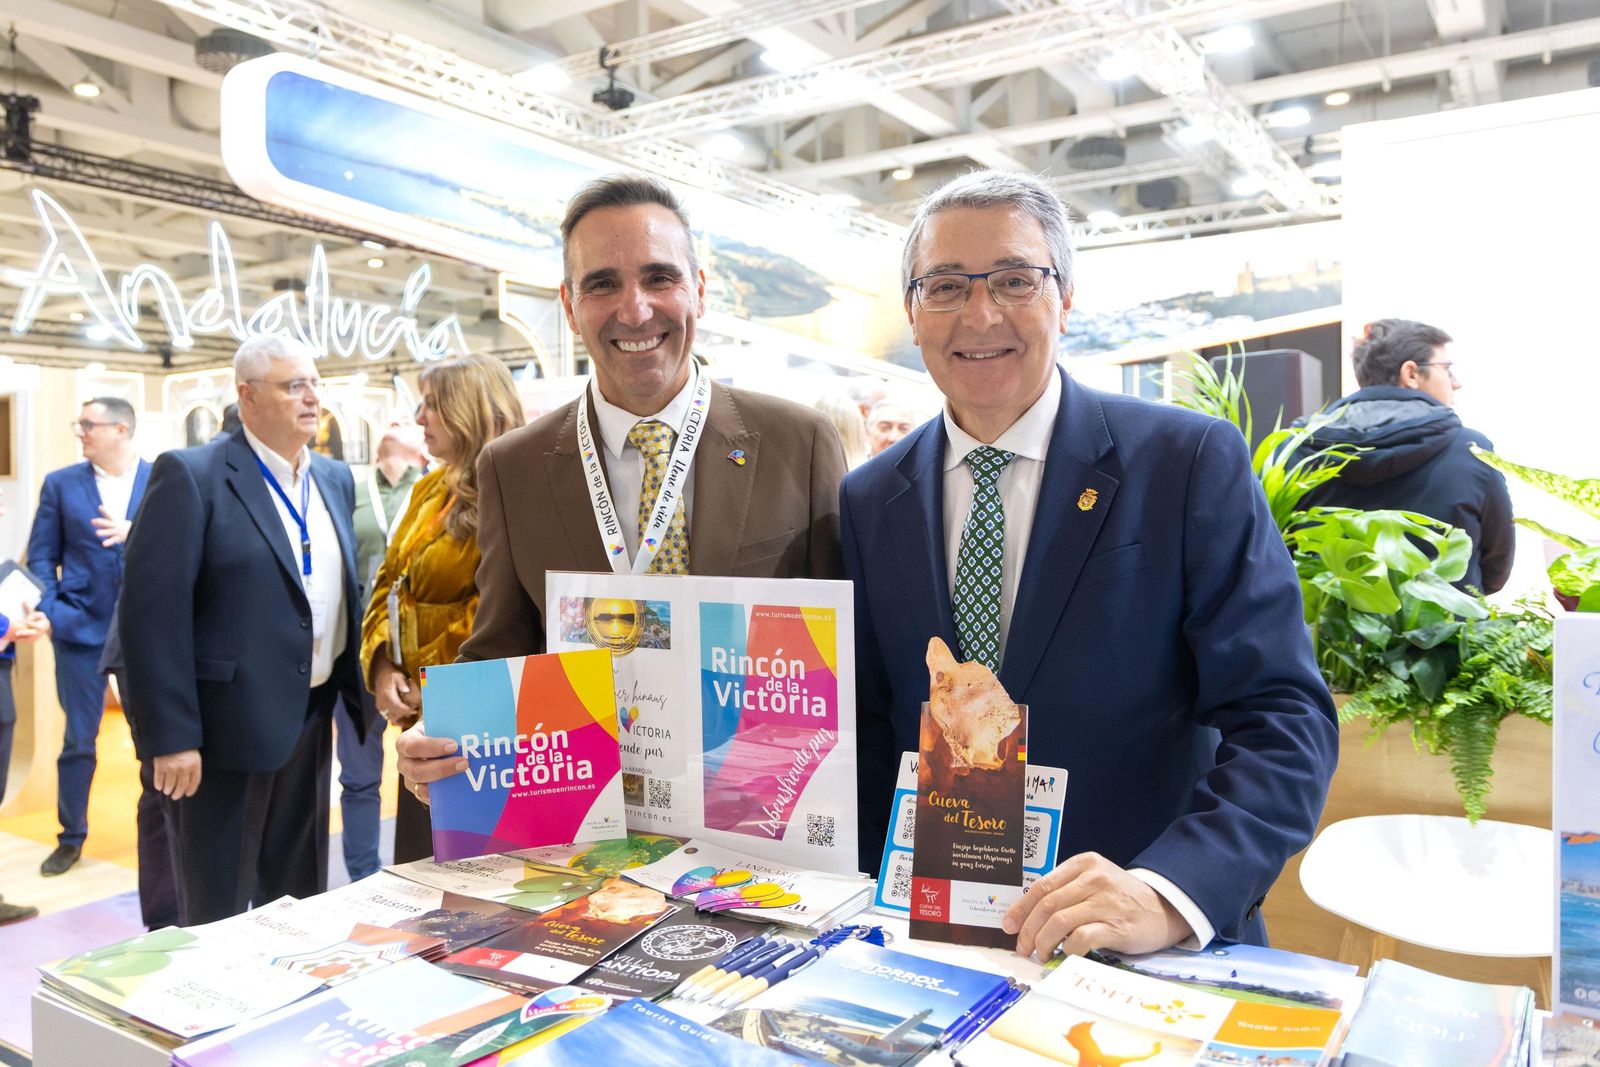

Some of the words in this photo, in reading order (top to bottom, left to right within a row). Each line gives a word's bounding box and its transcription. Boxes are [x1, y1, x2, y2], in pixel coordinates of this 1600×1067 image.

[3, 188, 469, 361] Andalucía
[589, 462, 598, 474] la
[592, 475, 603, 488] de
[664, 489, 675, 504] de
[595, 491, 618, 536] RINCÓN
[652, 504, 668, 530] vida
[711, 646, 806, 681] Rincón
[765, 676, 784, 693] de
[786, 677, 801, 694] la
[712, 679, 828, 718] Victoria
[460, 722, 569, 760] Rincón
[525, 750, 546, 767] de
[549, 748, 564, 764] la
[644, 745, 665, 761] pur
[464, 755, 594, 792] Victoria
[758, 744, 817, 838] Lebensfreude
[808, 727, 835, 761] pur
[511, 783, 597, 799] www.turismoenrincon.es
[928, 790, 971, 810] Cueva
[943, 812, 960, 824] del
[961, 810, 1008, 831] Tesoro
[368, 894, 423, 913] Raisins
[919, 909, 942, 917] TESORO
[544, 920, 581, 931] Cueva
[565, 930, 607, 945] Tesoro
[597, 959, 681, 981] ANTIOPA
[613, 953, 655, 969] VILLA
[867, 963, 945, 987] TORROX
[632, 1002, 676, 1028] Tourist
[679, 1022, 719, 1044] Guide
